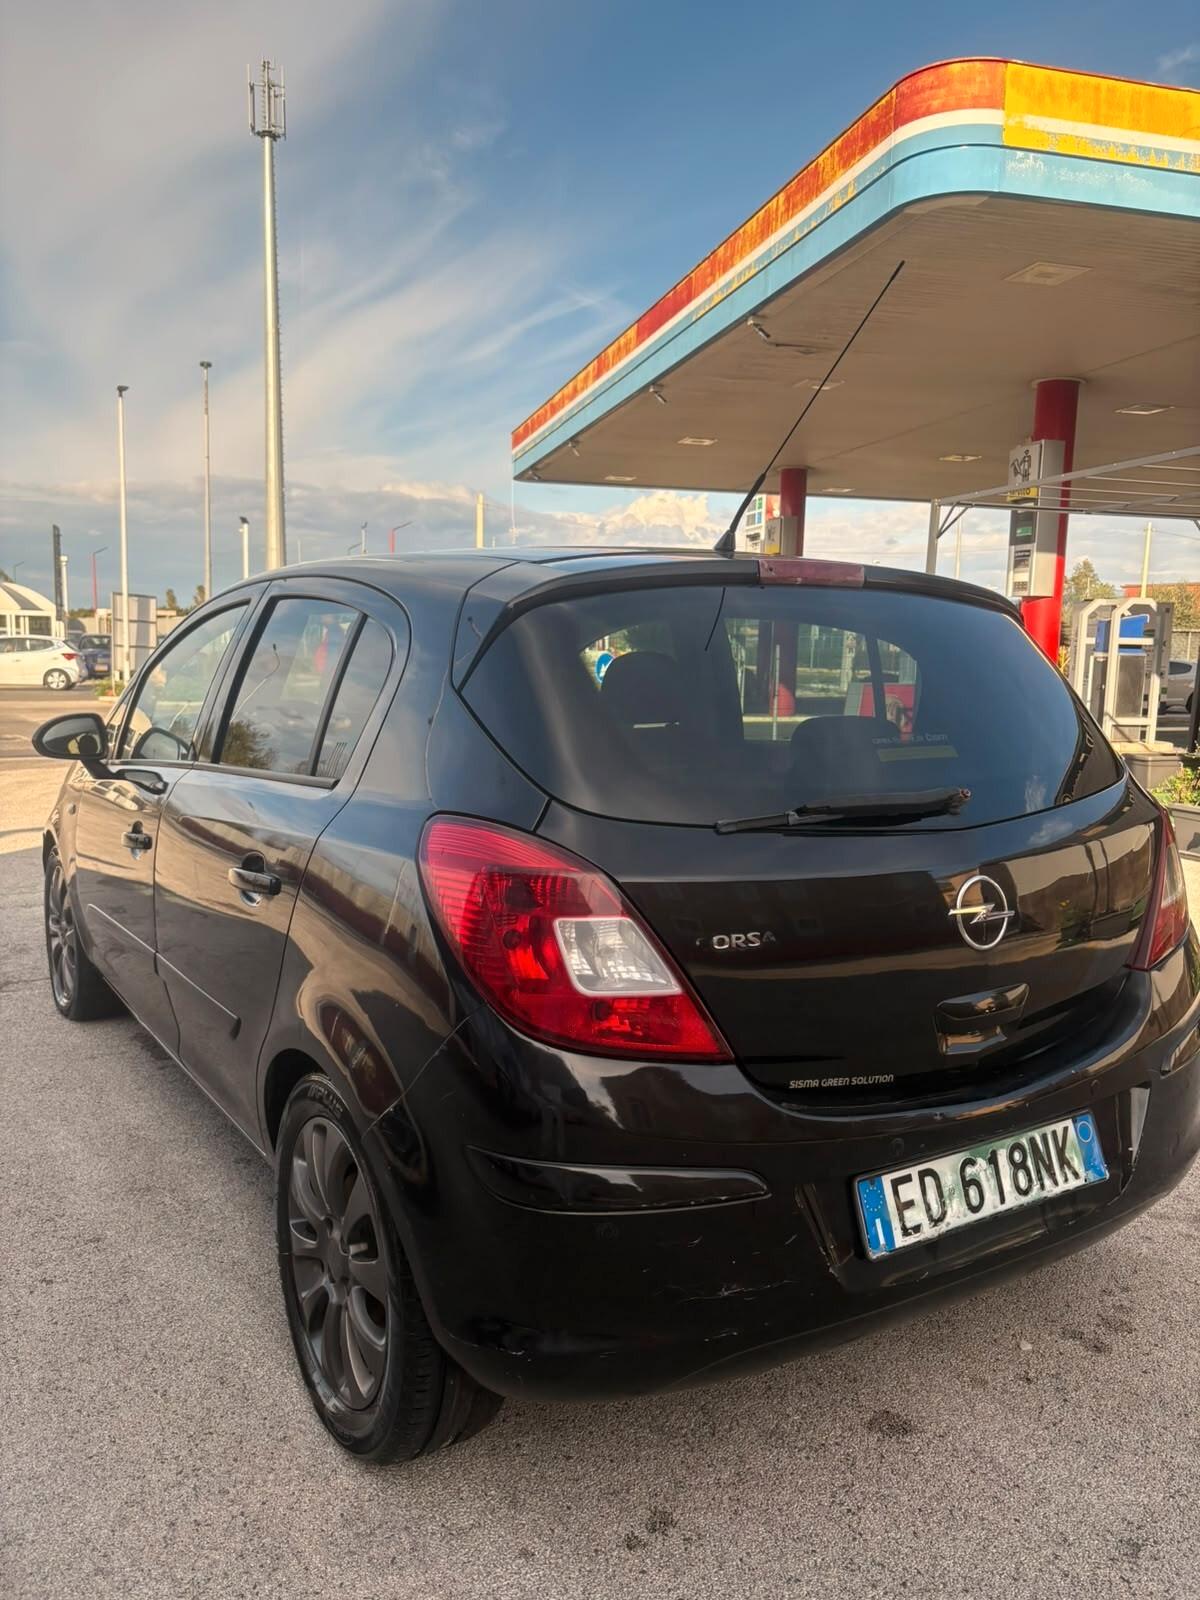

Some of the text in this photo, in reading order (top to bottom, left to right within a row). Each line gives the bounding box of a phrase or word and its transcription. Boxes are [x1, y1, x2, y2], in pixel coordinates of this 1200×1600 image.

[789, 1074, 894, 1089] SISMA GREEN SOLUTION
[890, 1126, 1080, 1237] ED 618NK
